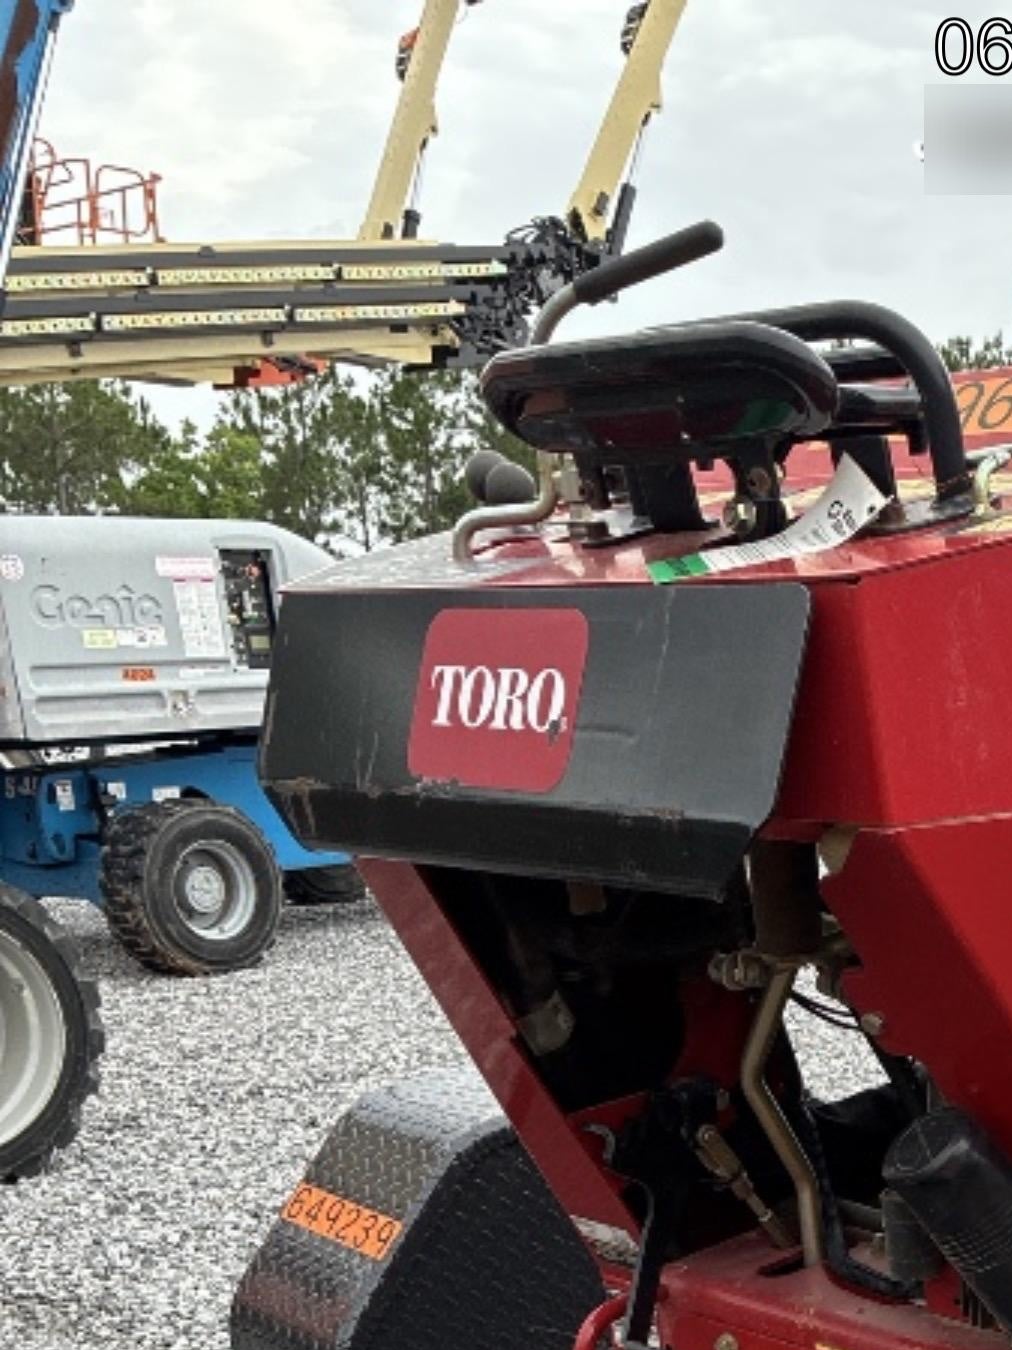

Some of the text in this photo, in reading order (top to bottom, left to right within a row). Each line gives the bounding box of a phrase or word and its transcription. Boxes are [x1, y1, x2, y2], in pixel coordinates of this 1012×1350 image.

[31, 584, 164, 629] Genie
[431, 665, 566, 733] TORO
[287, 1187, 396, 1257] 649239
